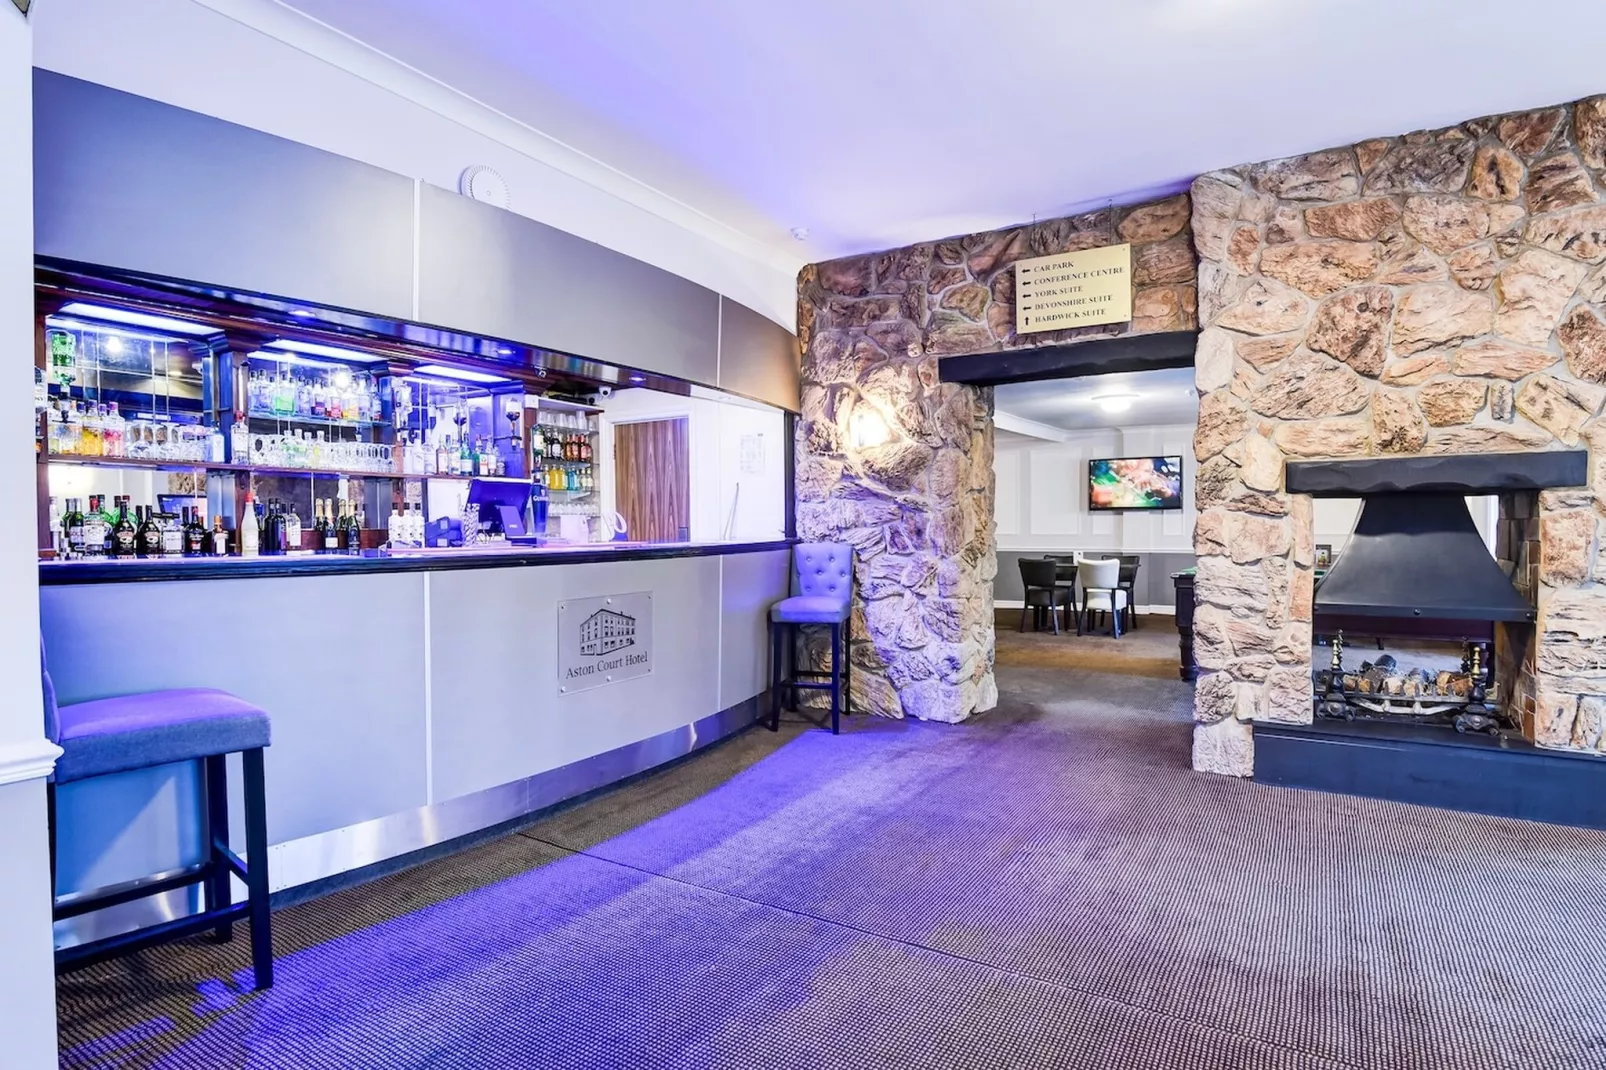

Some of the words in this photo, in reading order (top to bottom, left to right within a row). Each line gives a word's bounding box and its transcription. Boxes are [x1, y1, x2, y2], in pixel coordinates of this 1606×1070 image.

[1034, 264, 1050, 273] CAR
[1053, 261, 1074, 270] PARK
[1034, 272, 1089, 285] CONFERENCE
[1090, 267, 1125, 277] CENTRE
[1035, 288, 1057, 297] YORK
[1060, 285, 1083, 294] SUITE
[1035, 298, 1086, 310] DEVONSHIRE
[1088, 294, 1113, 302] SUITE
[1035, 311, 1080, 323] HARDWICK
[1082, 308, 1106, 317] SUITE
[565, 664, 594, 679] Aston
[597, 658, 623, 672] Court
[625, 651, 648, 666] Hotel
